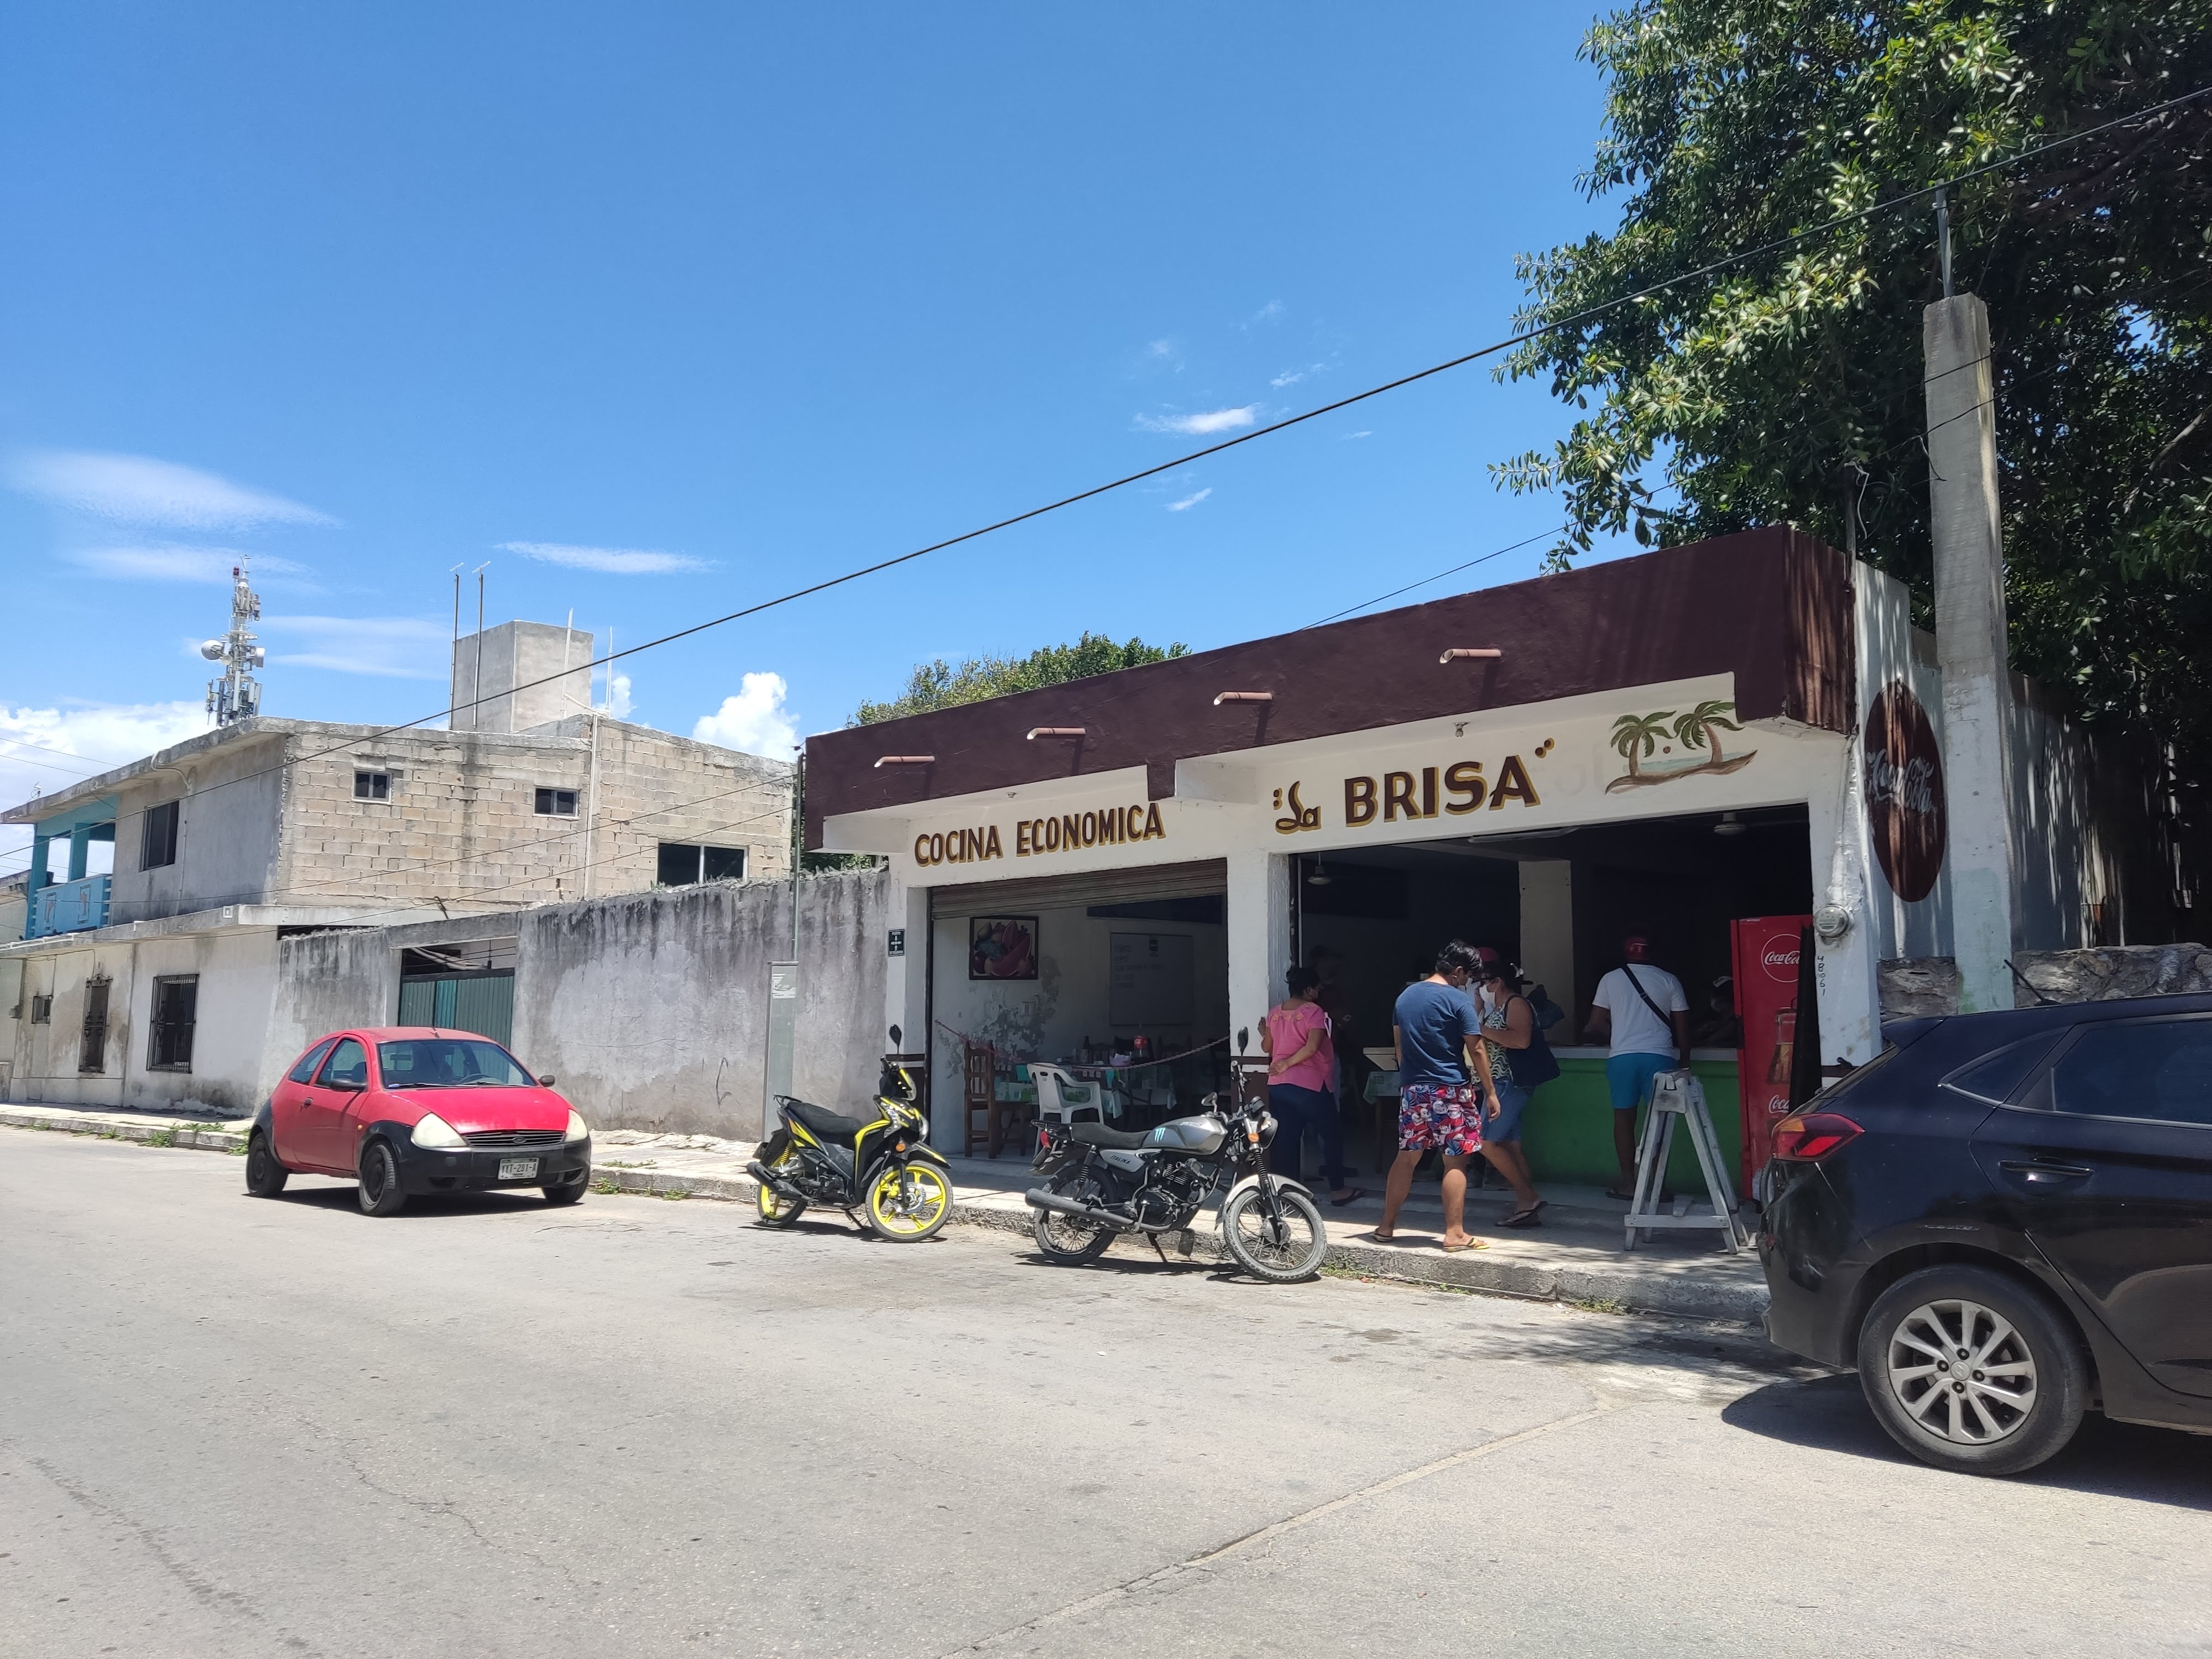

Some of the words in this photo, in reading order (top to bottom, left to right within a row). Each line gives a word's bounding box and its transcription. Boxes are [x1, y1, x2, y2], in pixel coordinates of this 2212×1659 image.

[1276, 780, 1322, 834] La
[1344, 754, 1541, 828] BRISA
[914, 825, 1004, 867] COCINA
[1016, 802, 1166, 857] ECONOMICA
[1764, 951, 1801, 965] Coca-Col
